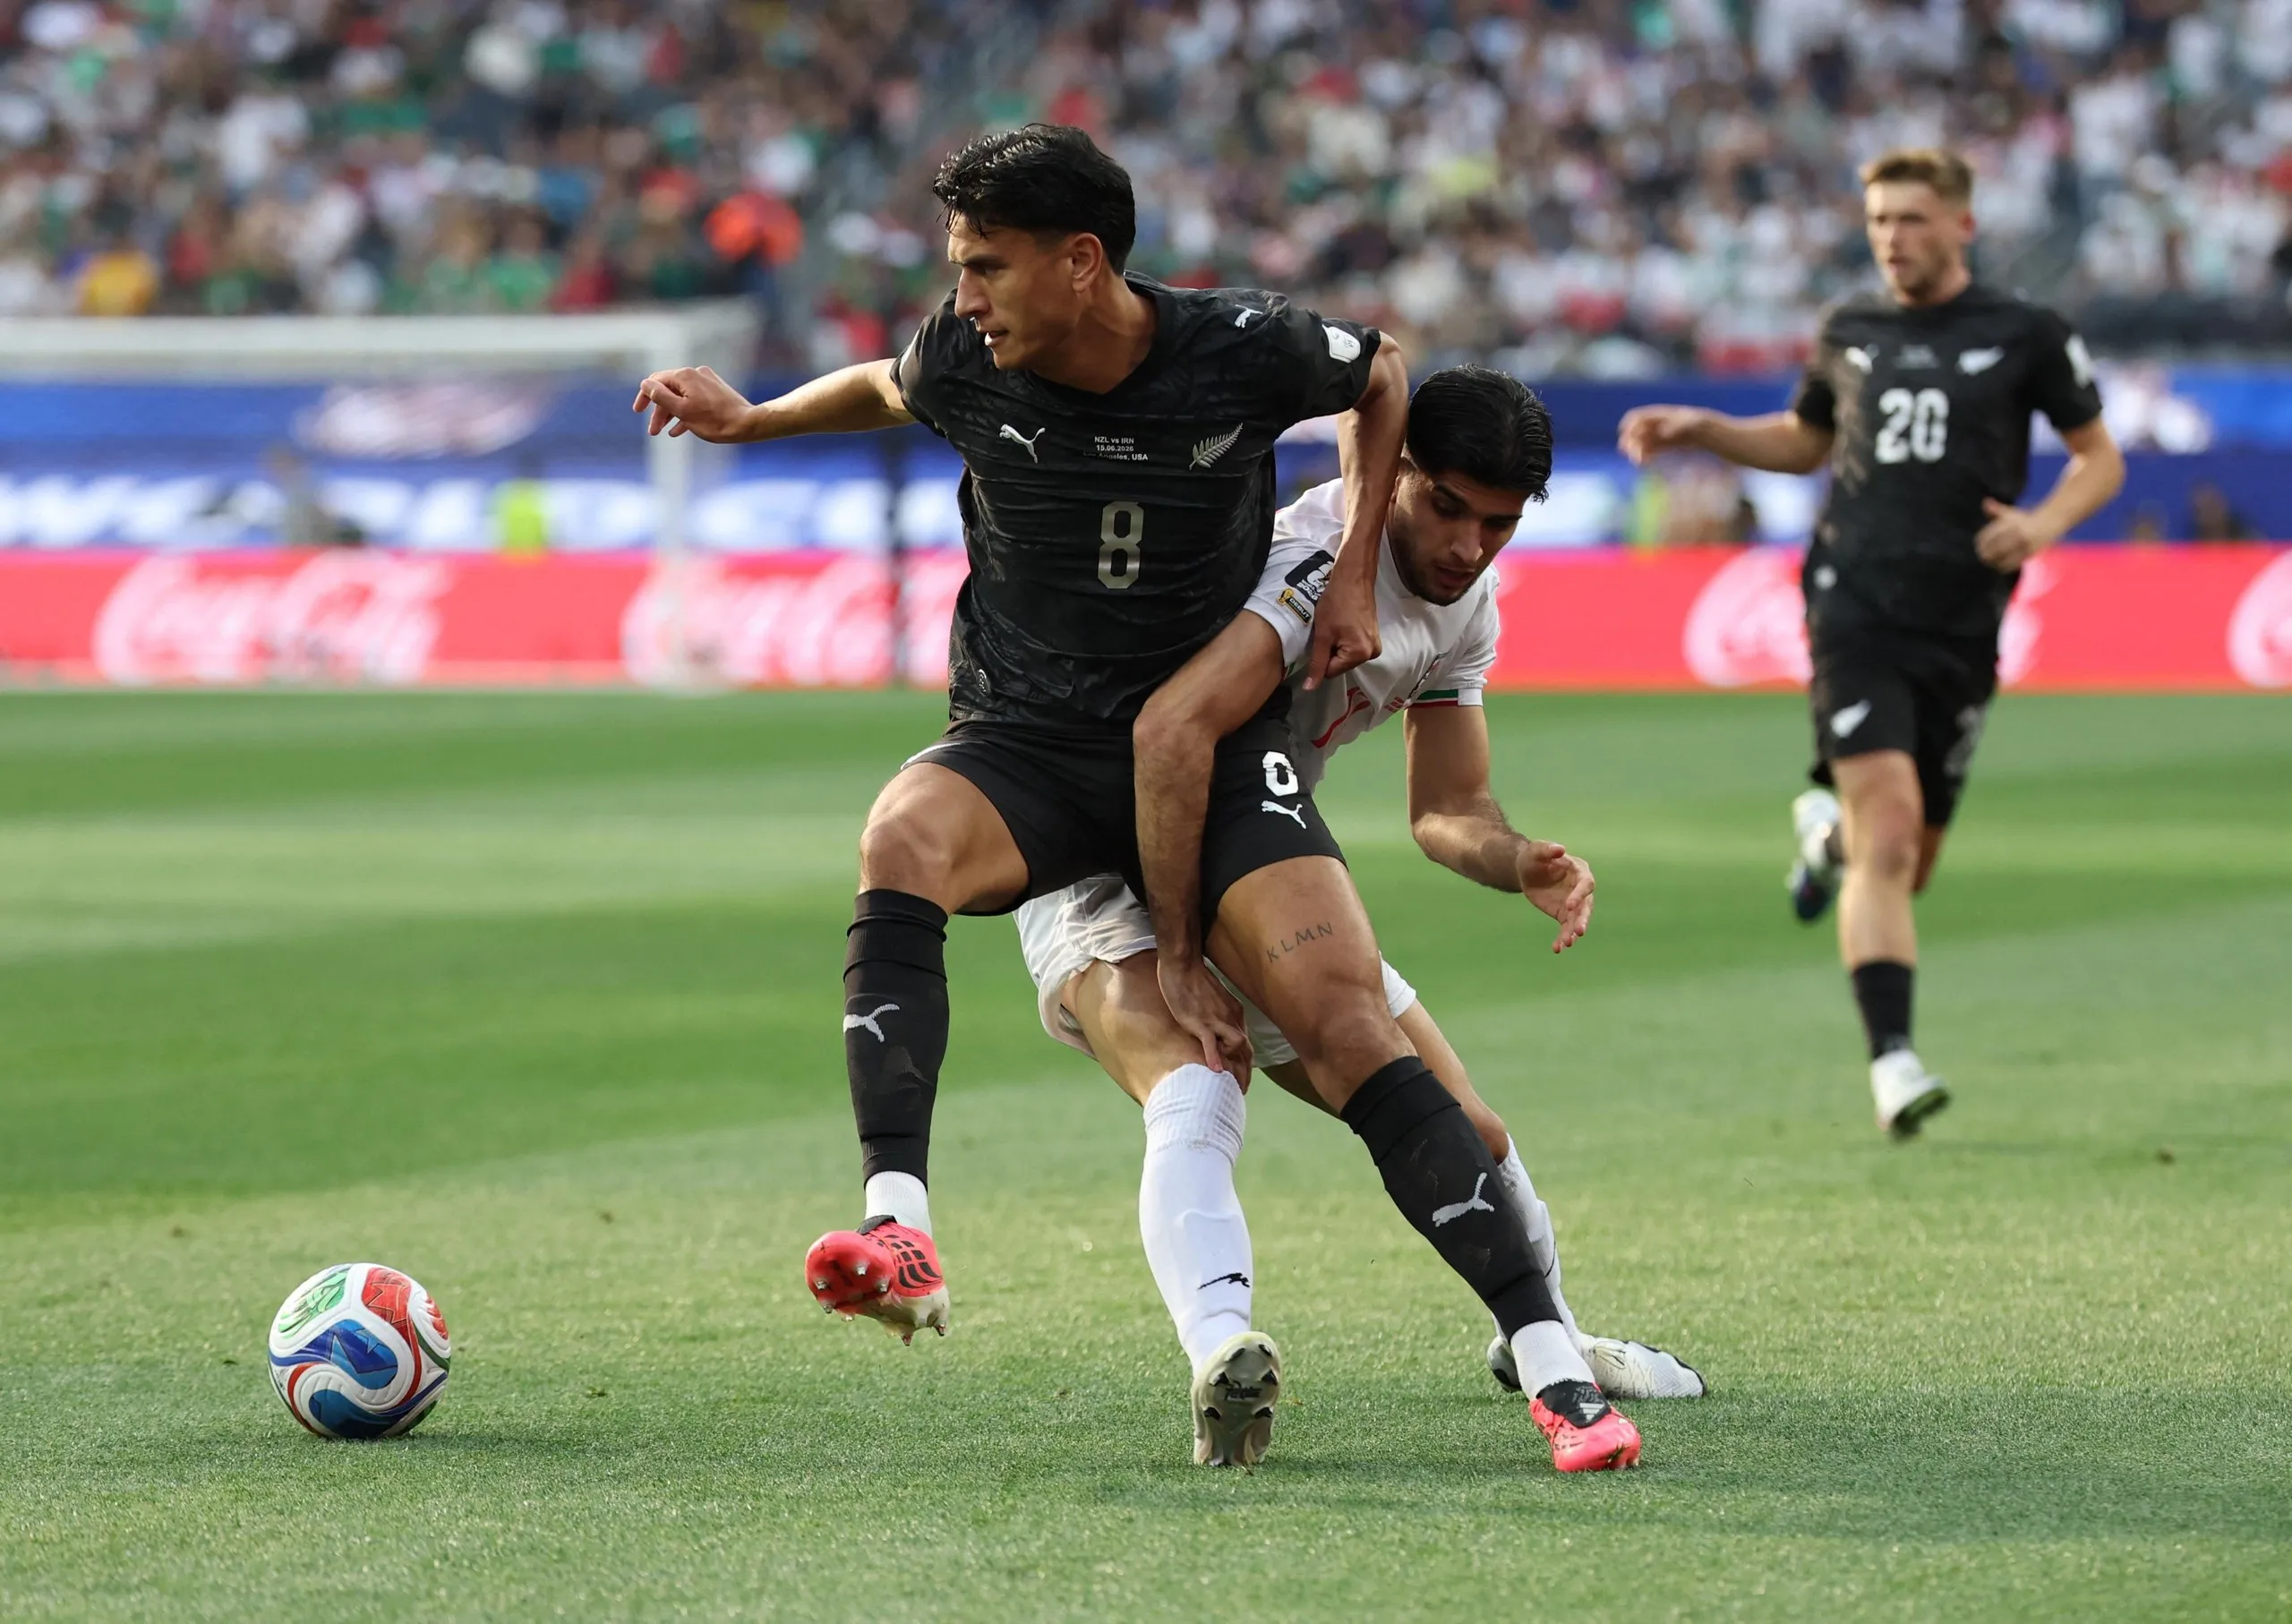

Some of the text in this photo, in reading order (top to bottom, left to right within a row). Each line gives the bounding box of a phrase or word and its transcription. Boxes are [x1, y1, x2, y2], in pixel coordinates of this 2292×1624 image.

[1875, 387, 1950, 465] 20
[1096, 444, 1134, 452] 15.06.2026
[1131, 453, 1149, 461] USA
[1098, 501, 1144, 589] 8
[1289, 598, 1310, 618] DEBUT
